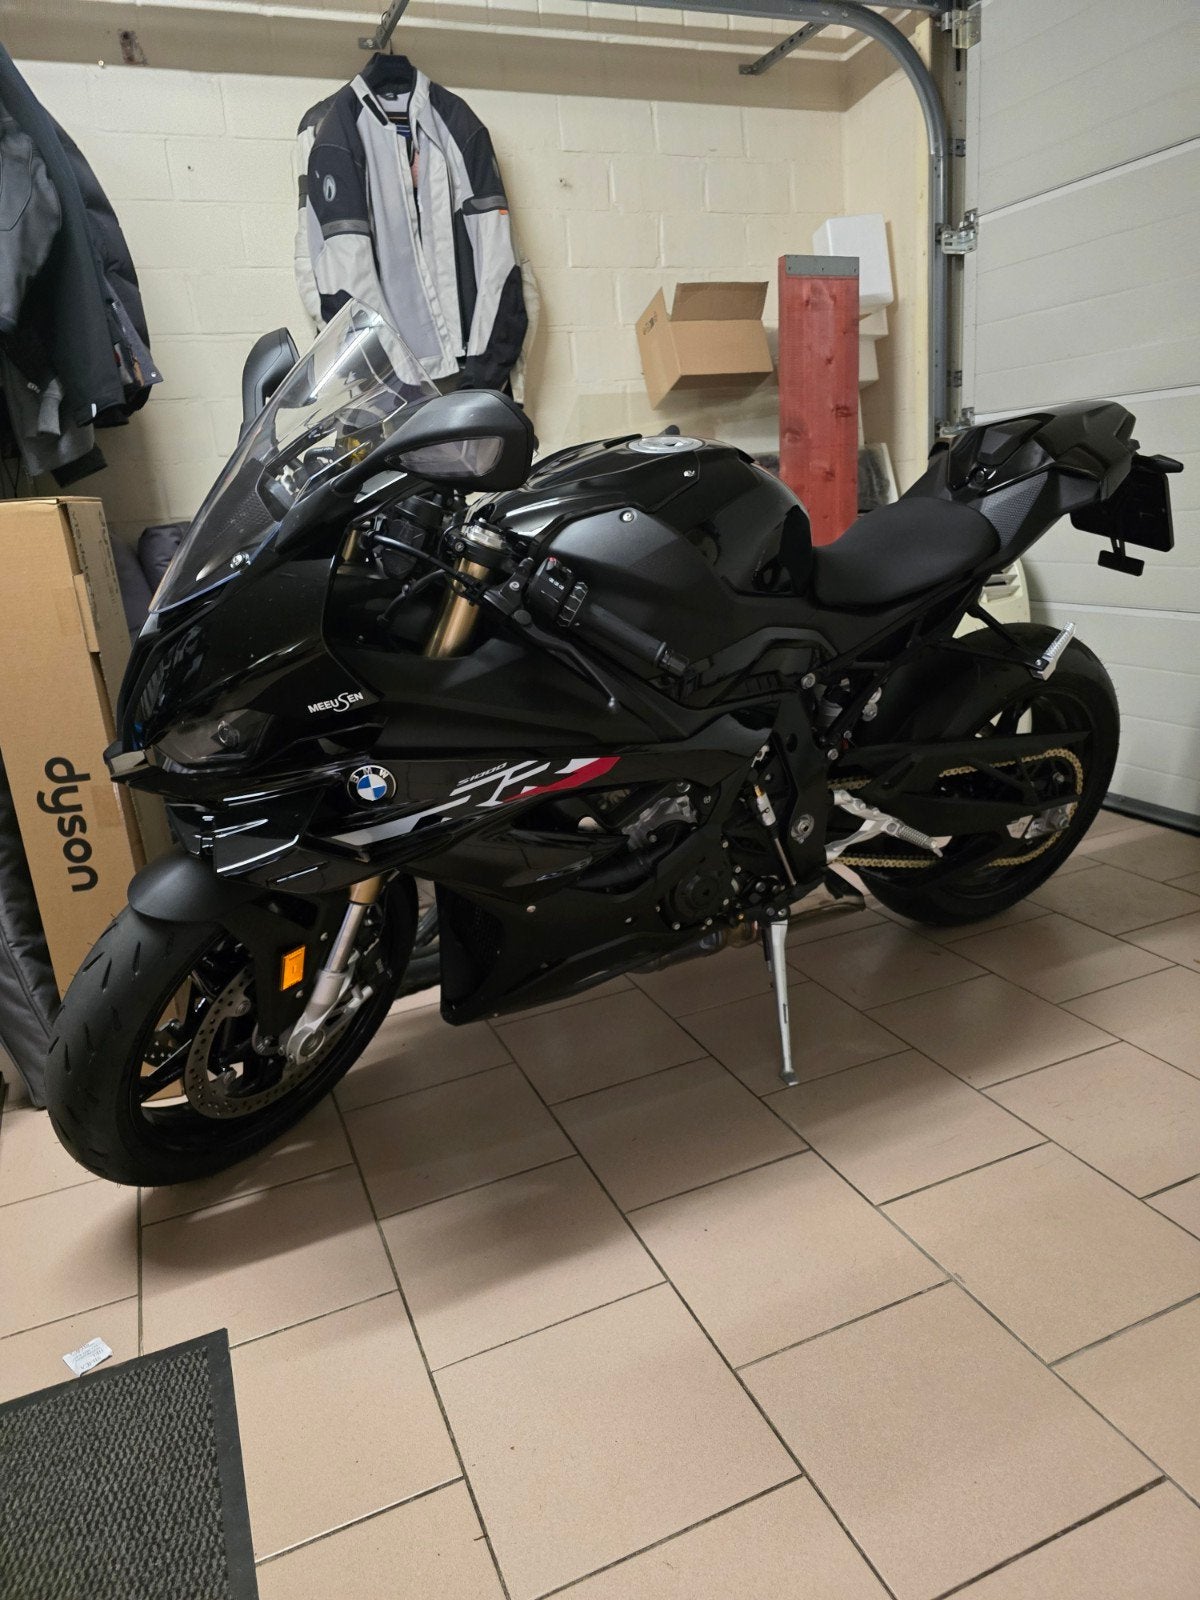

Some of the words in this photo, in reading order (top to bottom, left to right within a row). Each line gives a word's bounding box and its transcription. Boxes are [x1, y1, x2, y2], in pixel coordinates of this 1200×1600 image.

[307, 692, 364, 713] MEEUSEN
[351, 767, 389, 783] BMW
[37, 757, 99, 892] dyson
